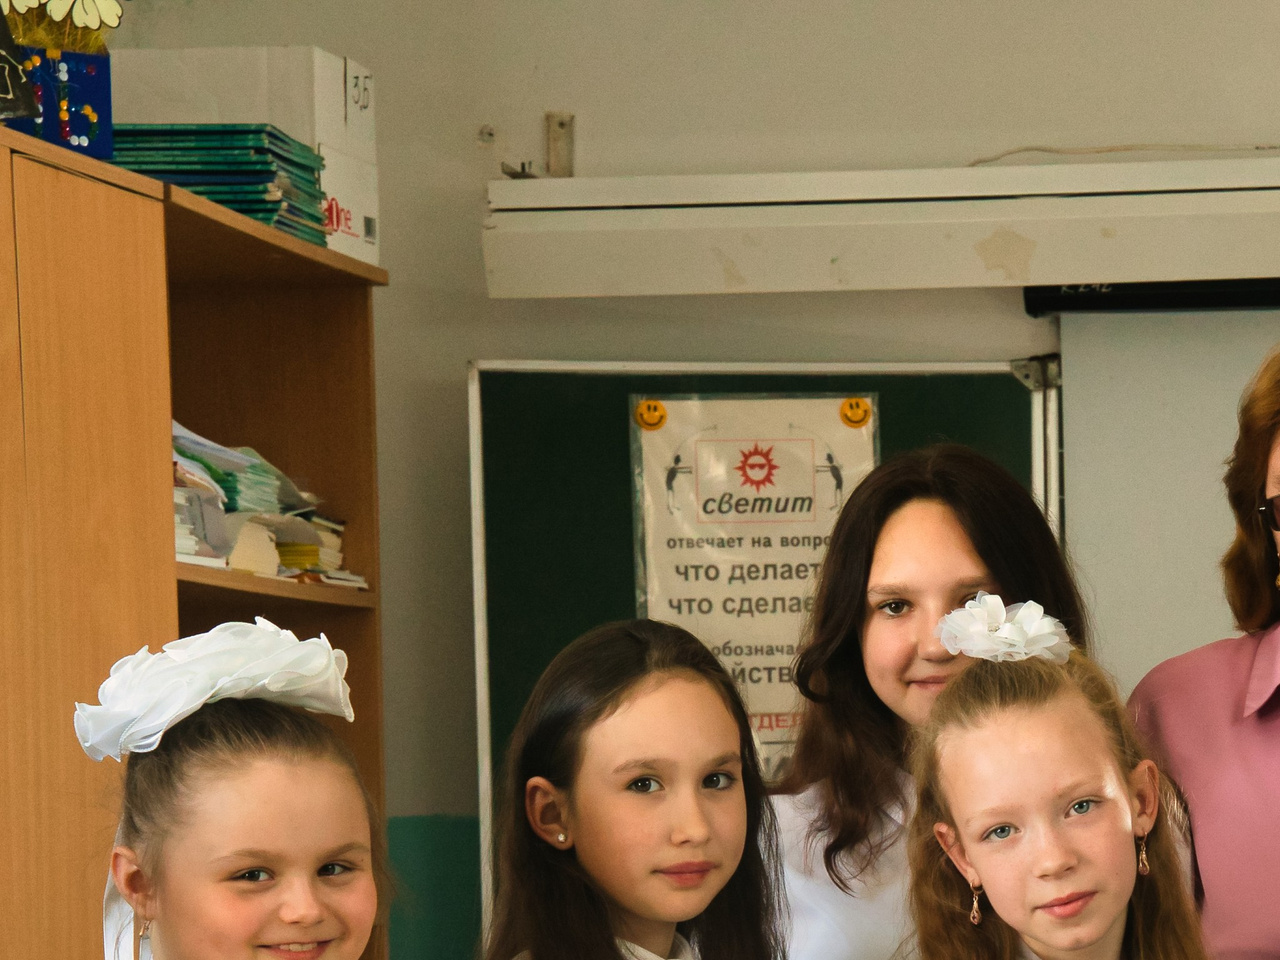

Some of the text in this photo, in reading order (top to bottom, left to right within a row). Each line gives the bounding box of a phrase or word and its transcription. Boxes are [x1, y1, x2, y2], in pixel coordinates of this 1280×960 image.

[702, 492, 813, 515] светит
[666, 535, 831, 552] отвечает на вопро
[675, 564, 720, 581] что
[668, 596, 816, 617] что сделае
[711, 639, 796, 657] обознача
[731, 661, 793, 683] йств
